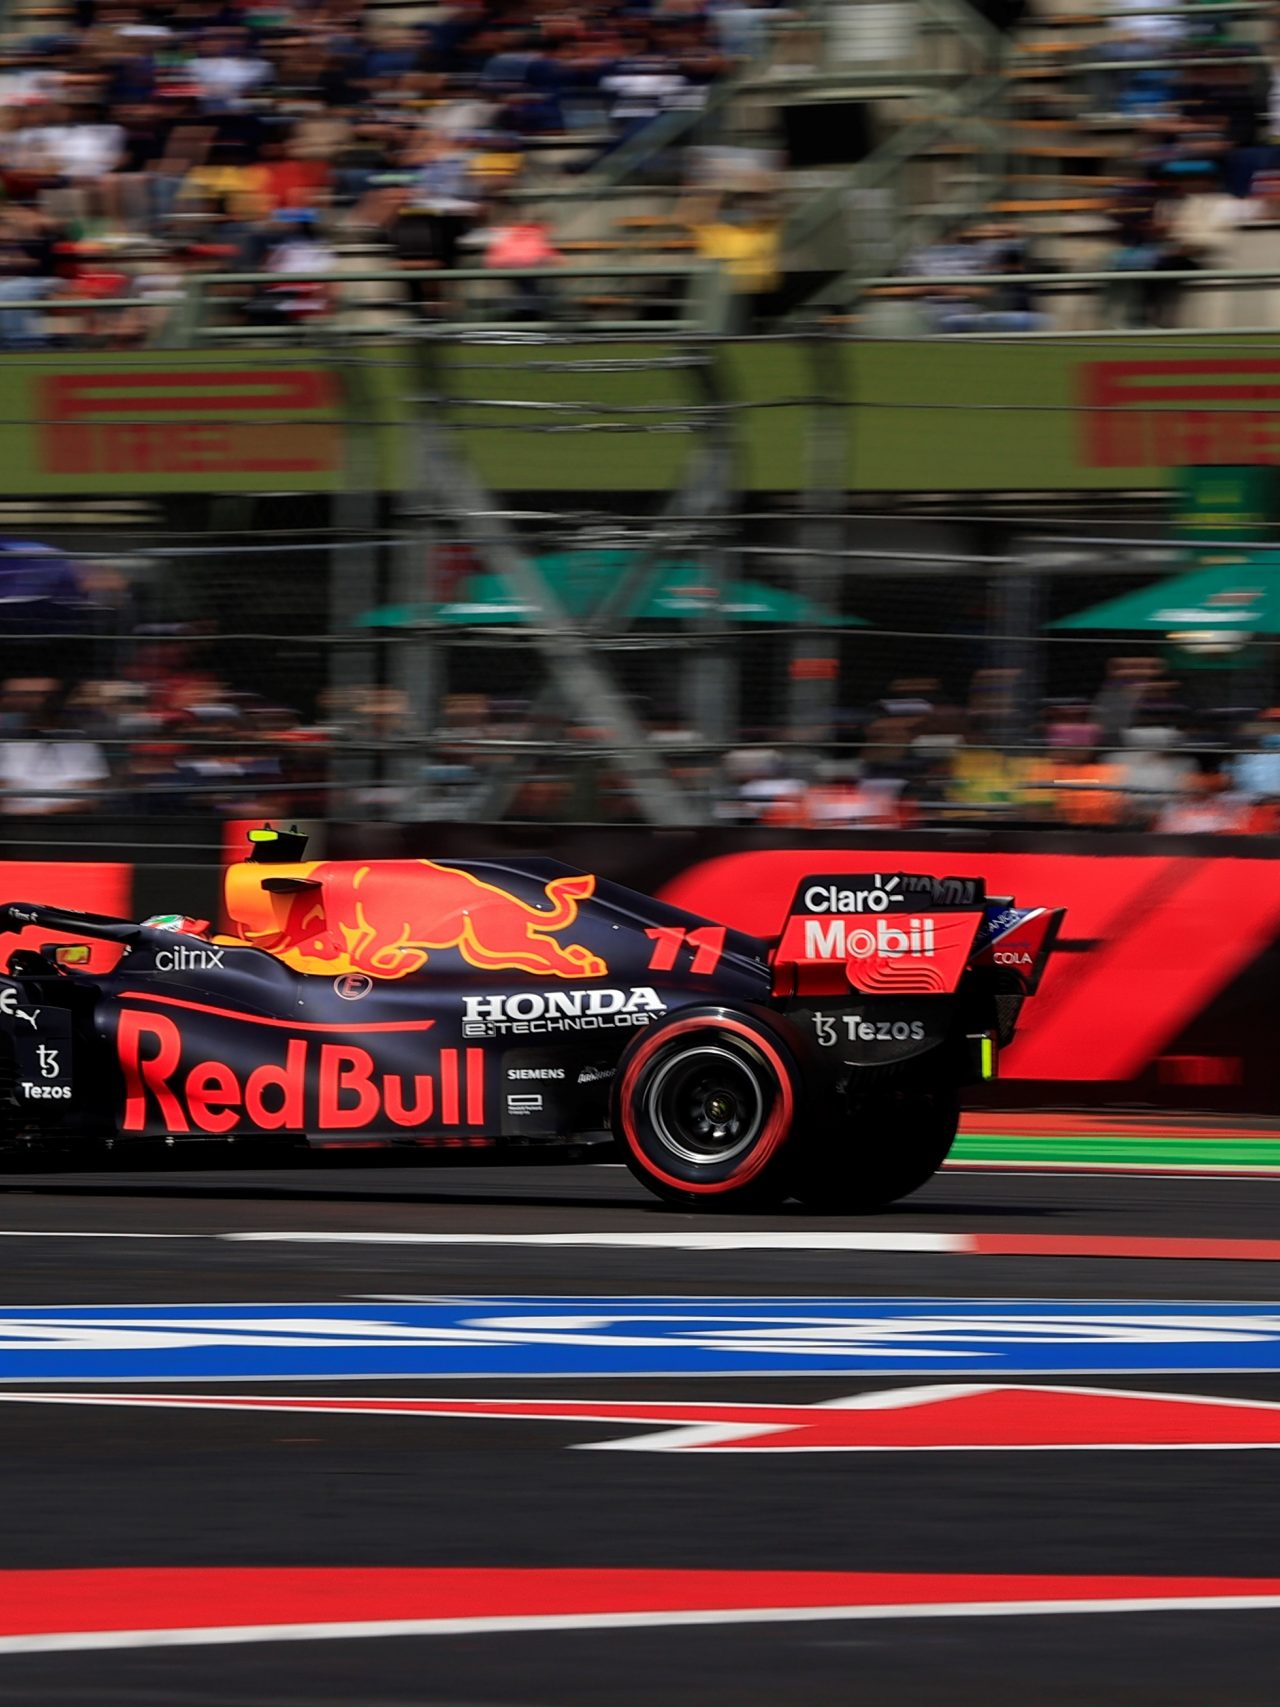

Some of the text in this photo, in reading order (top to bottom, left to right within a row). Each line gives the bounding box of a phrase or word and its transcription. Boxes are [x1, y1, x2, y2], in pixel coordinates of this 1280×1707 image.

[804, 882, 893, 913] Claro
[644, 926, 727, 976] 11
[803, 917, 936, 960] Mobil
[154, 945, 225, 972] citrix
[992, 951, 1034, 966] COLA
[461, 986, 667, 1022] HONDA
[842, 1014, 926, 1042] Tezos
[506, 1067, 567, 1081] SIEMENS
[21, 1082, 72, 1100] Tezos
